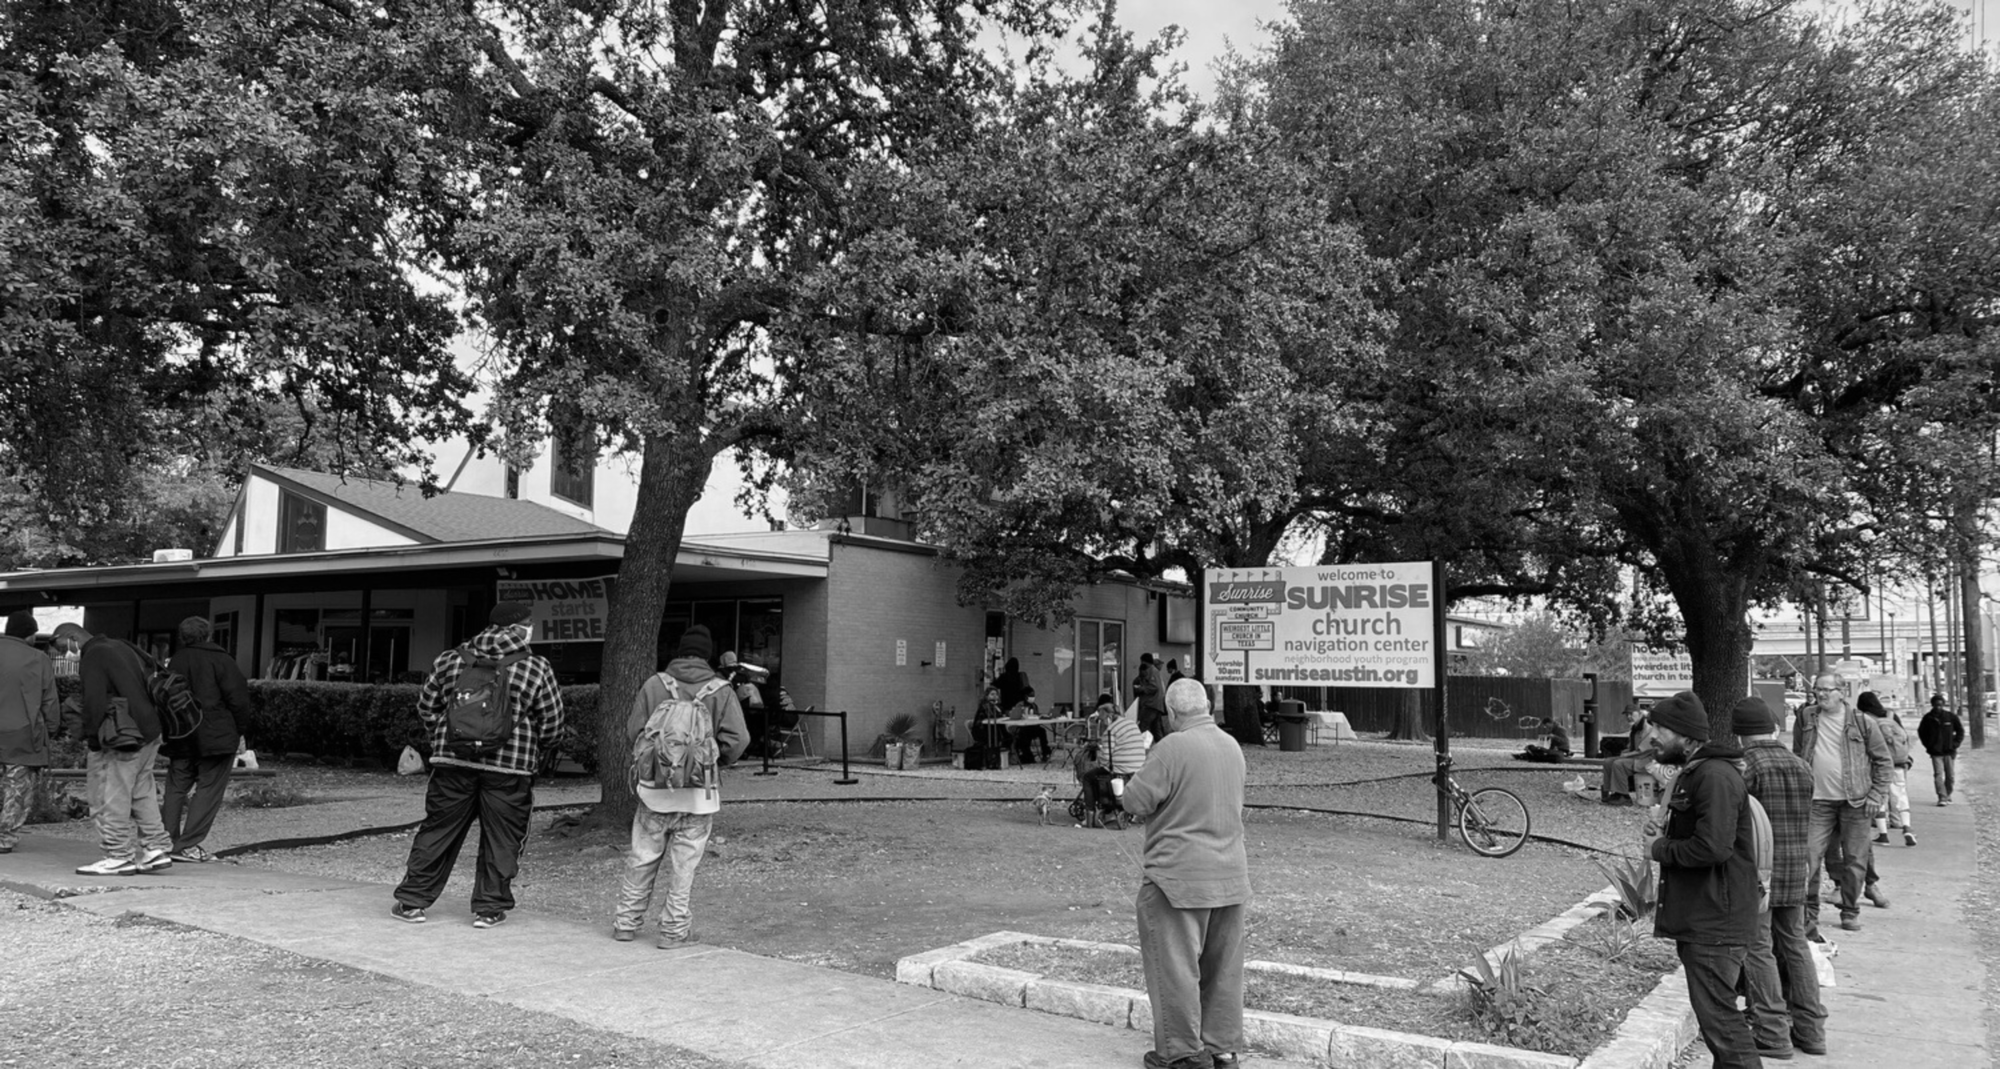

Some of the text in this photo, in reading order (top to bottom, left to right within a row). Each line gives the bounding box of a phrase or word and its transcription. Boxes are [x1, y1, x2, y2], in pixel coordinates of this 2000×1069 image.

[1318, 569, 1395, 581] welcome to
[532, 580, 604, 600] HOME
[1217, 583, 1274, 602] Sunrise
[1287, 583, 1430, 610] SUNRISE
[551, 601, 596, 616] starts
[542, 618, 602, 640] HERE
[1312, 611, 1402, 636] church
[1284, 637, 1429, 655] navigation center
[1284, 654, 1429, 665] neighborhood youth program
[1633, 662, 1693, 671] weirdest lit
[1218, 667, 1241, 675] 10am
[1255, 664, 1418, 685] sunriseaustin.org
[1633, 672, 1666, 680] church
[1668, 672, 1676, 680] in
